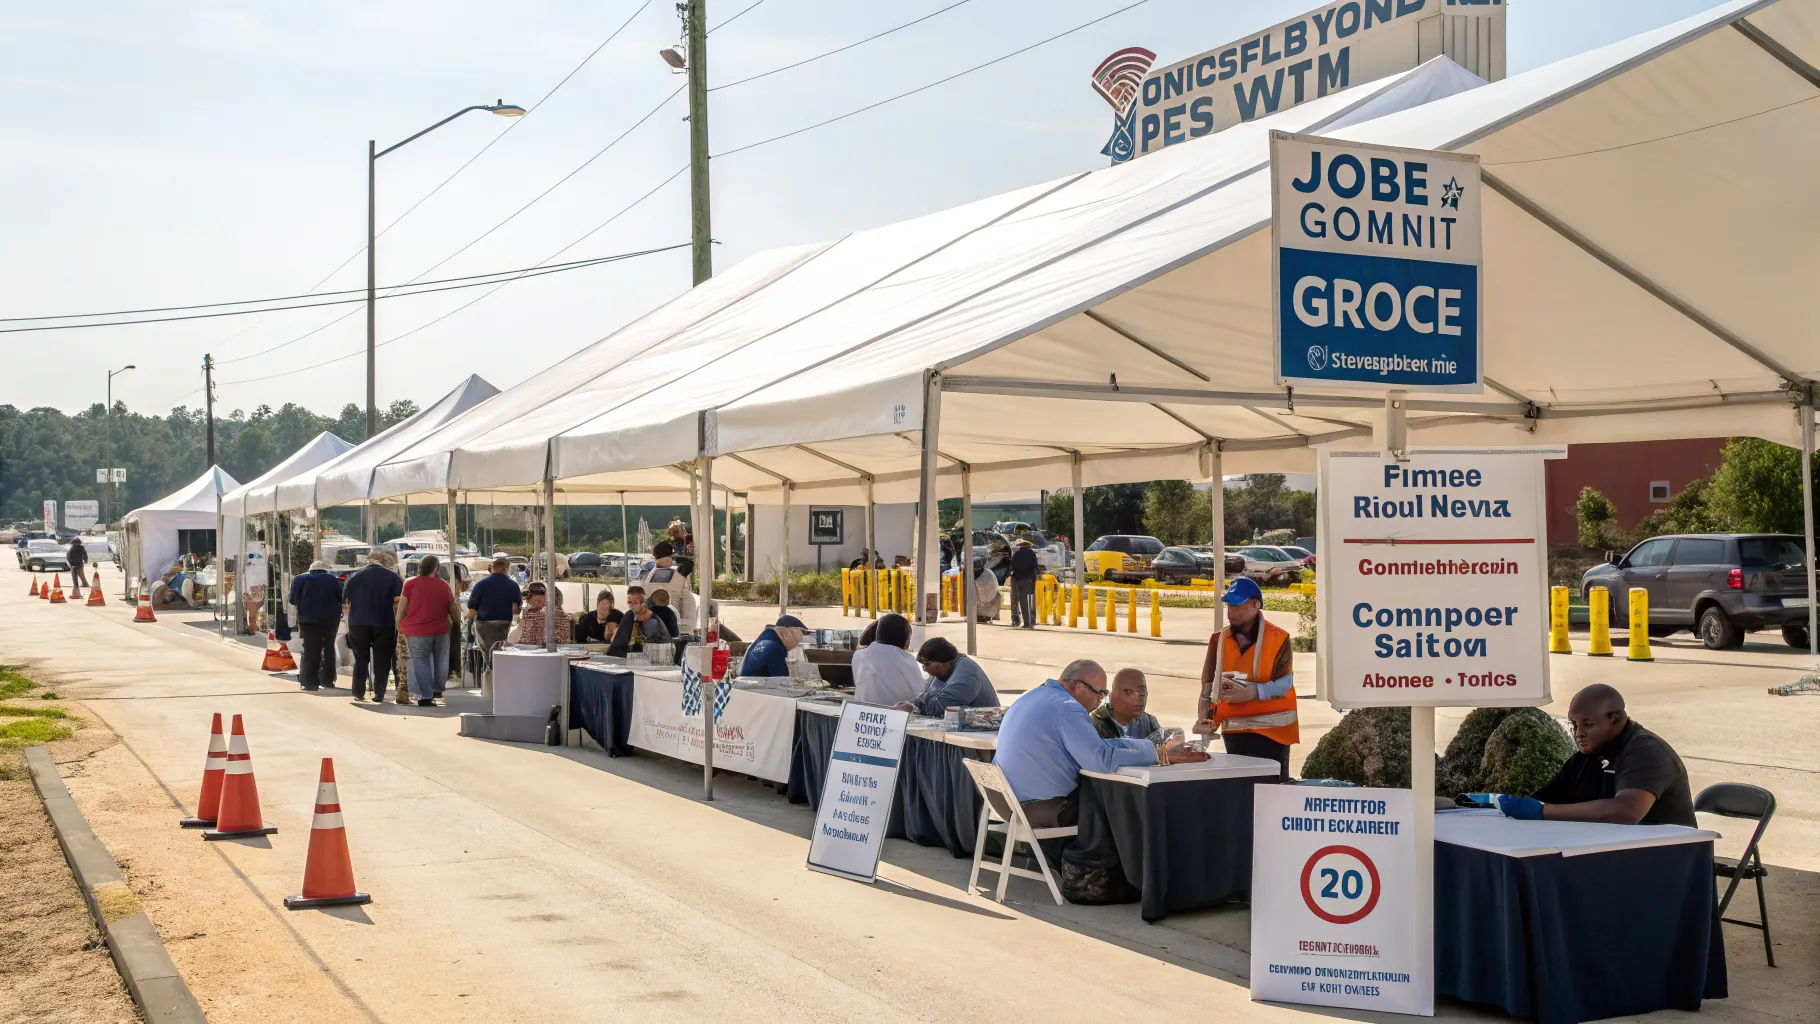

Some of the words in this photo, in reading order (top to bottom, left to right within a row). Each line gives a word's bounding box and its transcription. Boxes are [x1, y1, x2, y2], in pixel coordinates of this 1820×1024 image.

[1141, 97, 1214, 153] PES
[1233, 46, 1350, 122] WTM
[1292, 152, 1429, 206] JOBE
[1300, 202, 1456, 250] GOMNIT
[1293, 275, 1462, 336] GROCE
[1362, 673, 1434, 688] Abonee
[1320, 868, 1363, 900] 20
